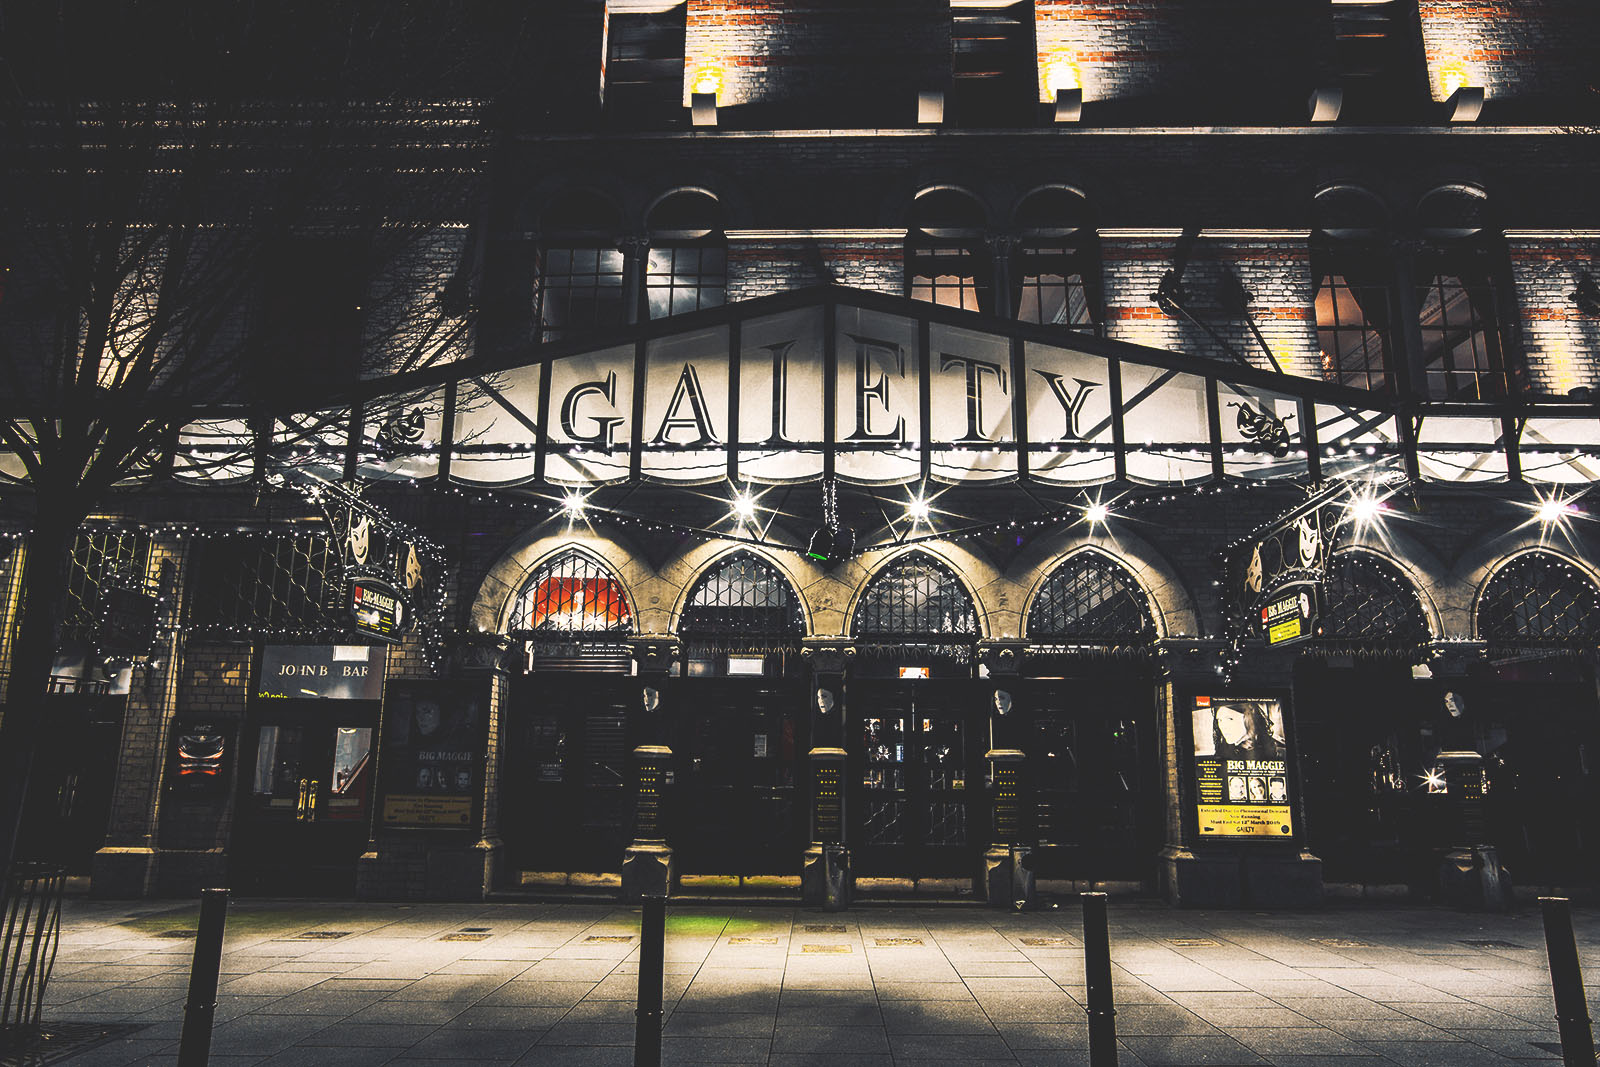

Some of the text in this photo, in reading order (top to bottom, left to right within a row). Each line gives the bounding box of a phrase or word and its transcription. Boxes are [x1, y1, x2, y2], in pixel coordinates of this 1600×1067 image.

[561, 333, 1104, 457] GAIETY
[362, 588, 374, 604] BIG
[278, 664, 369, 677] JOHN B BAR
[418, 751, 473, 761] BIG MAGGIE
[1226, 760, 1286, 771] BIG MAGGIE
